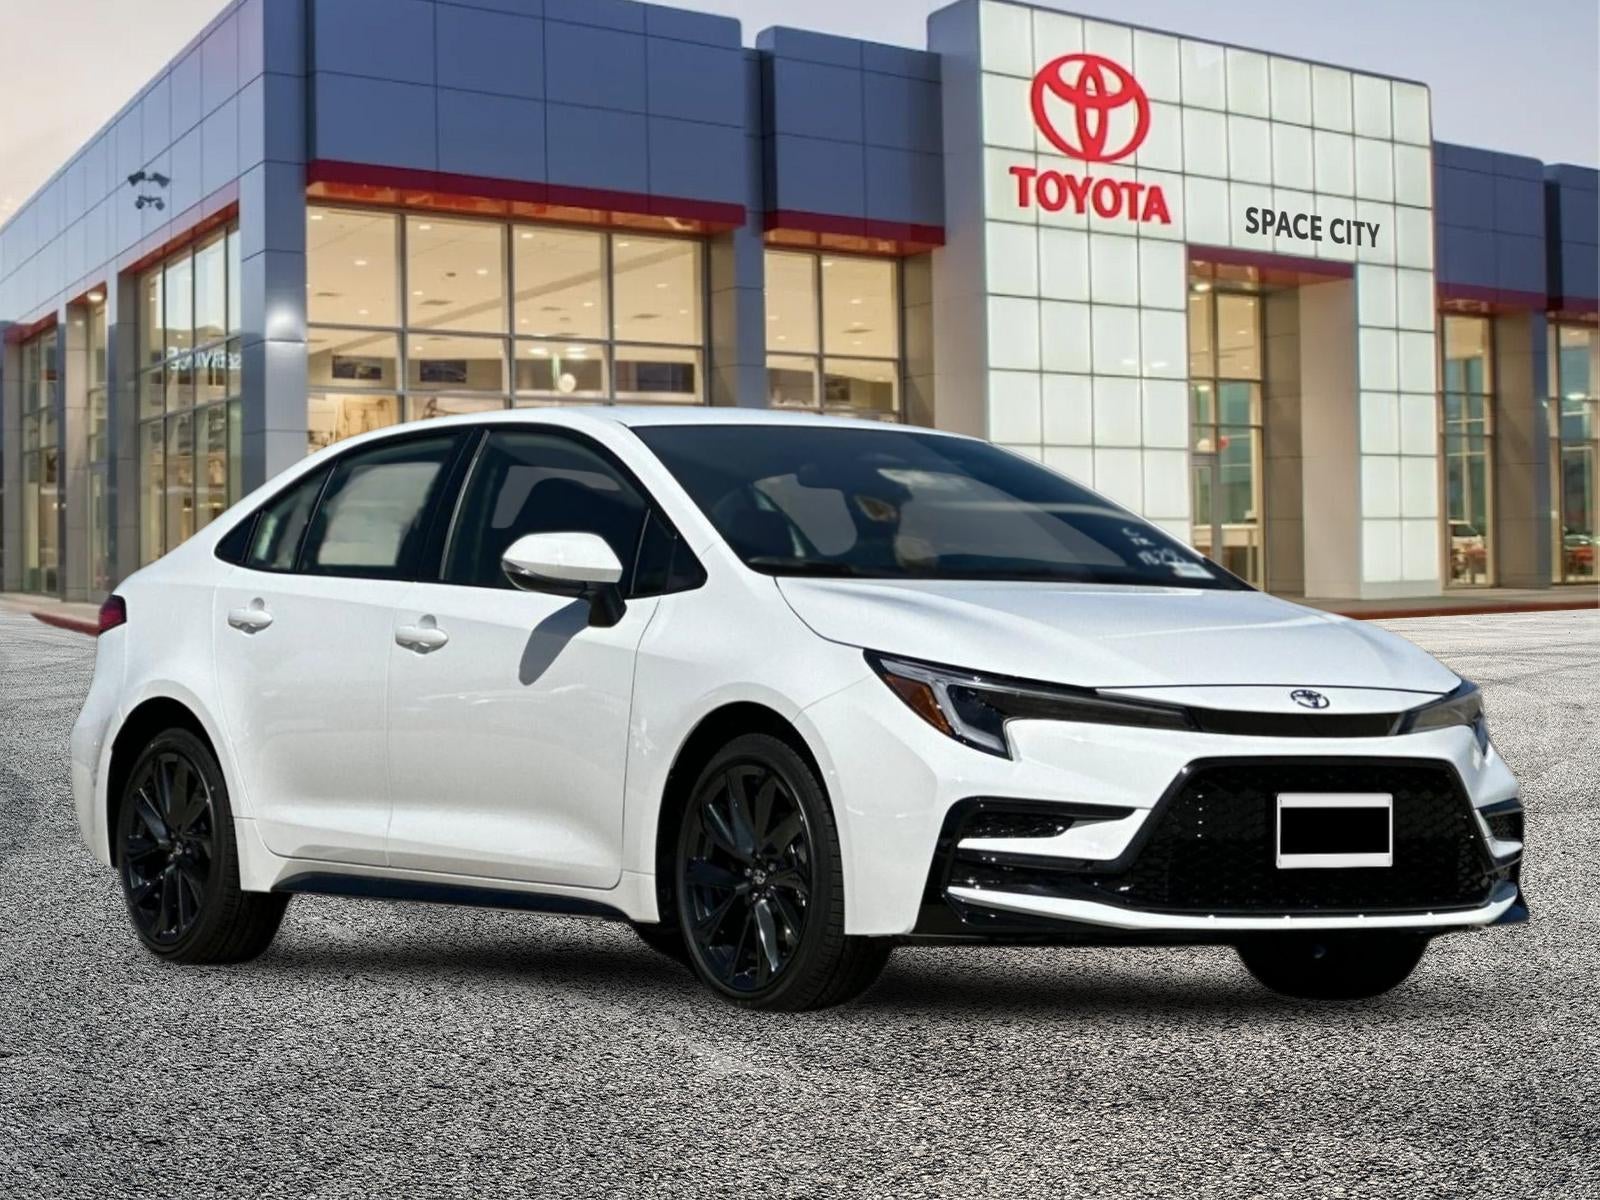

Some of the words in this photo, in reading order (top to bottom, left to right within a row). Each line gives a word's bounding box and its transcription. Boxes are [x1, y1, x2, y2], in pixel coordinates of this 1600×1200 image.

[1009, 165, 1172, 225] TOYOTA
[1245, 206, 1323, 242] SPACE
[1329, 218, 1380, 248] CITY
